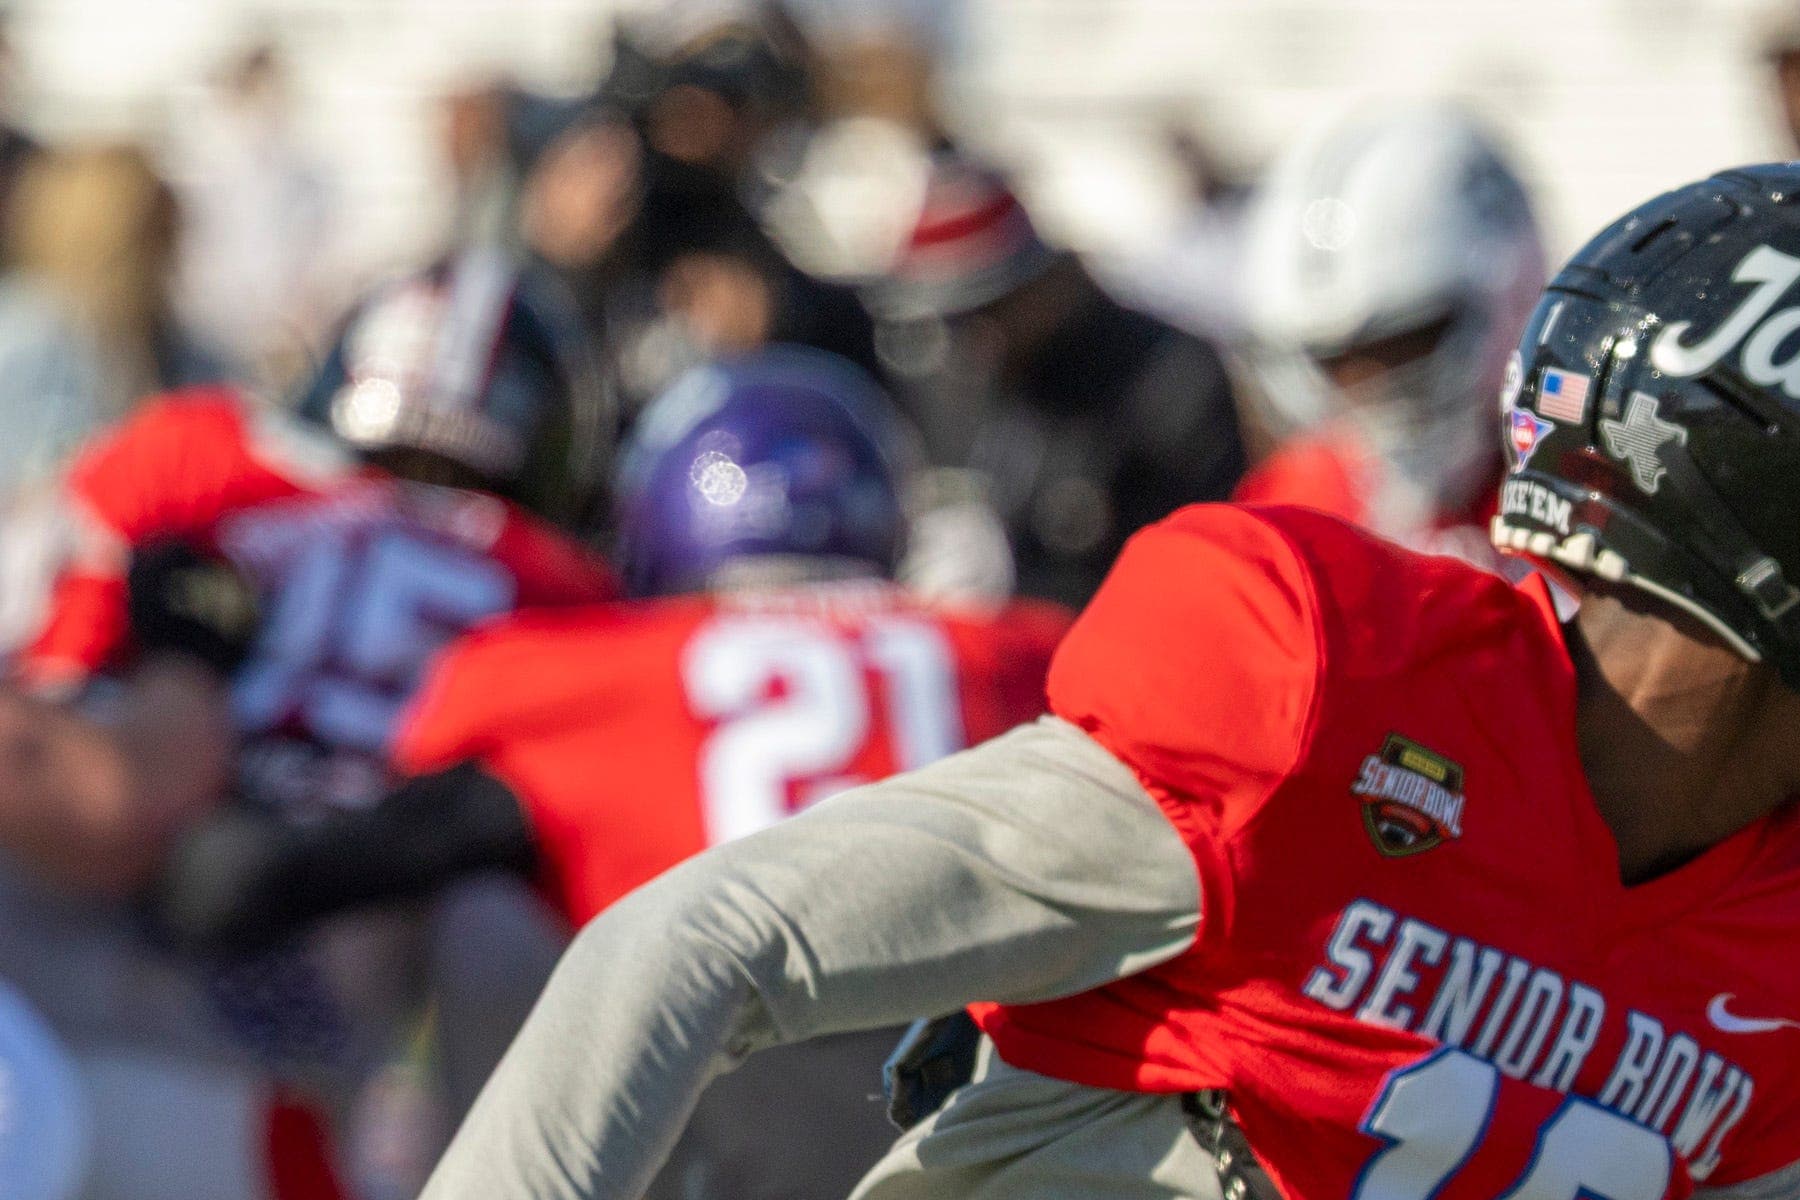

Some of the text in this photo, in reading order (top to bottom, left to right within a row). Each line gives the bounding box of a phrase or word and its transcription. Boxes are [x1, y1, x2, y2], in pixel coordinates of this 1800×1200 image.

[680, 610, 965, 850] 21
[1351, 755, 1424, 806] SENIOR
[1302, 897, 1754, 1181] SENIOR BOWL
